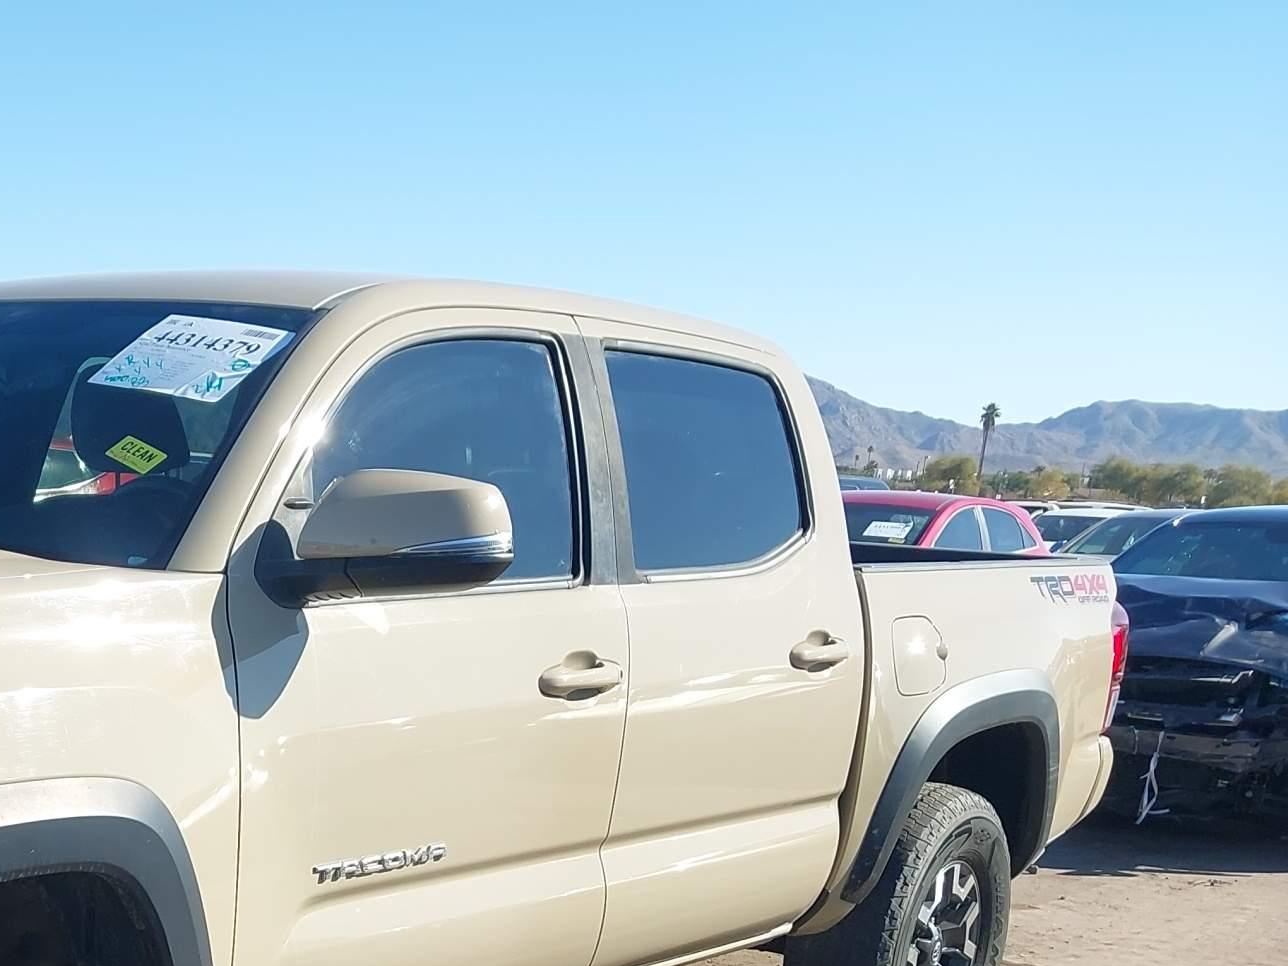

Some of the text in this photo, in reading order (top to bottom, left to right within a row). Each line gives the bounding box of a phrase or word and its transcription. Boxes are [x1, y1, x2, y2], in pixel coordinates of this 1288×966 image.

[154, 330, 261, 357] 44314379
[121, 441, 158, 463] CLEAN
[1030, 575, 1075, 604] TRD
[312, 845, 446, 884] TACOMA
